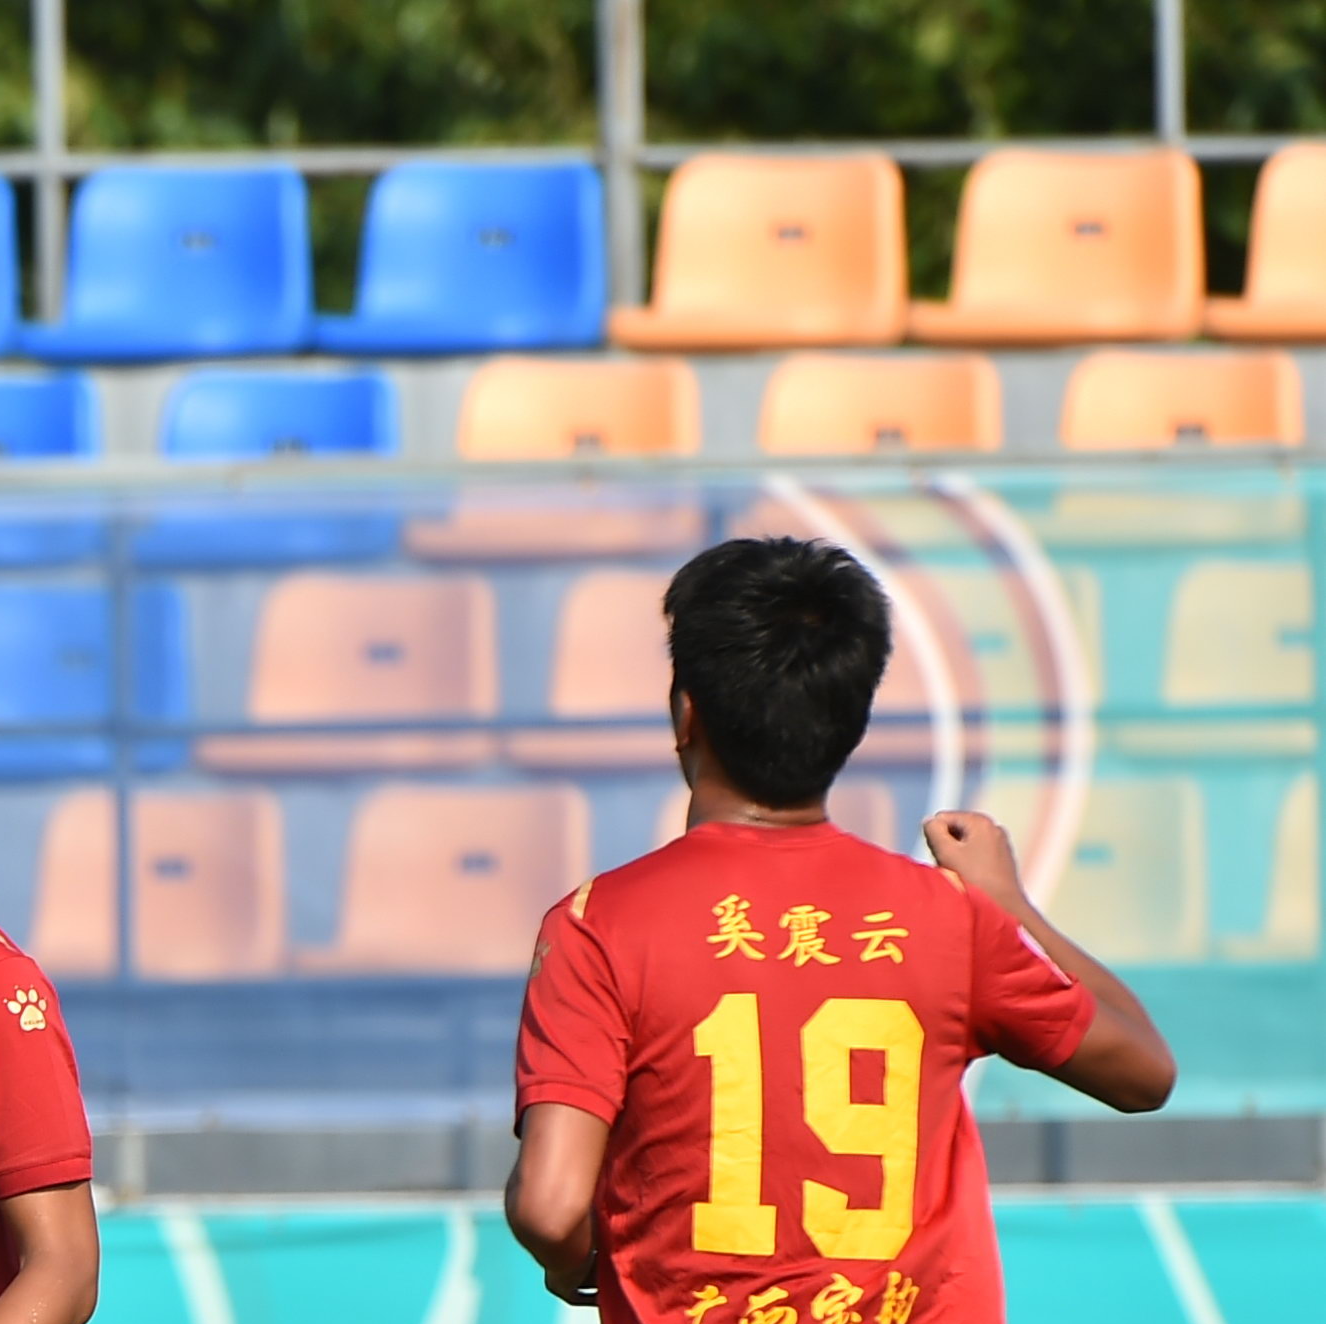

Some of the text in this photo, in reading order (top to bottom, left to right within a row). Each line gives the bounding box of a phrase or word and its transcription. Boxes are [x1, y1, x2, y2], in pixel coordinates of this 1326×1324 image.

[705, 893, 910, 968] 奚震云
[691, 992, 926, 1260] 19
